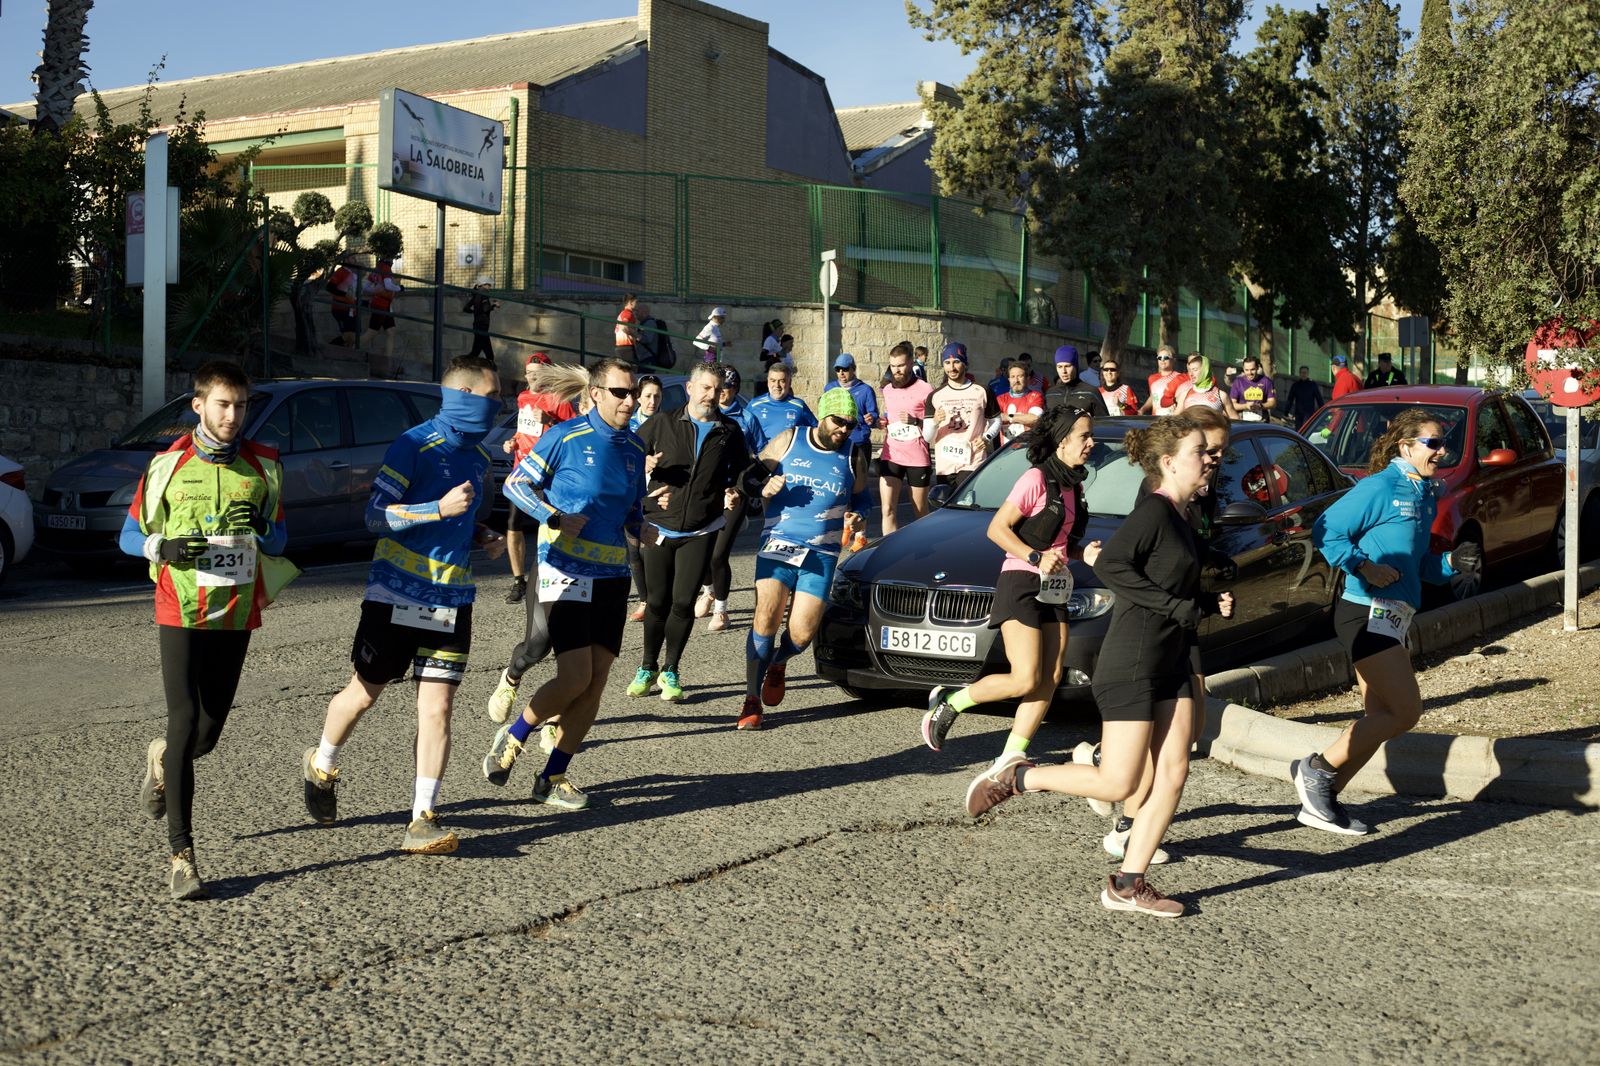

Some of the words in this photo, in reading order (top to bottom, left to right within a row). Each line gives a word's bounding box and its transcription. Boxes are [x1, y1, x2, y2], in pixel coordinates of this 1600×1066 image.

[410, 144, 423, 164] LA
[426, 149, 485, 181] SALOBREJA
[897, 425, 911, 436] 217
[949, 446, 964, 455] 218
[384, 519, 411, 528] SPORTS
[774, 544, 796, 554] 133
[214, 552, 244, 568] 231
[1049, 579, 1067, 590] 223
[1385, 609, 1402, 629] 240
[891, 630, 932, 651] 5812
[938, 634, 972, 654] GCG
